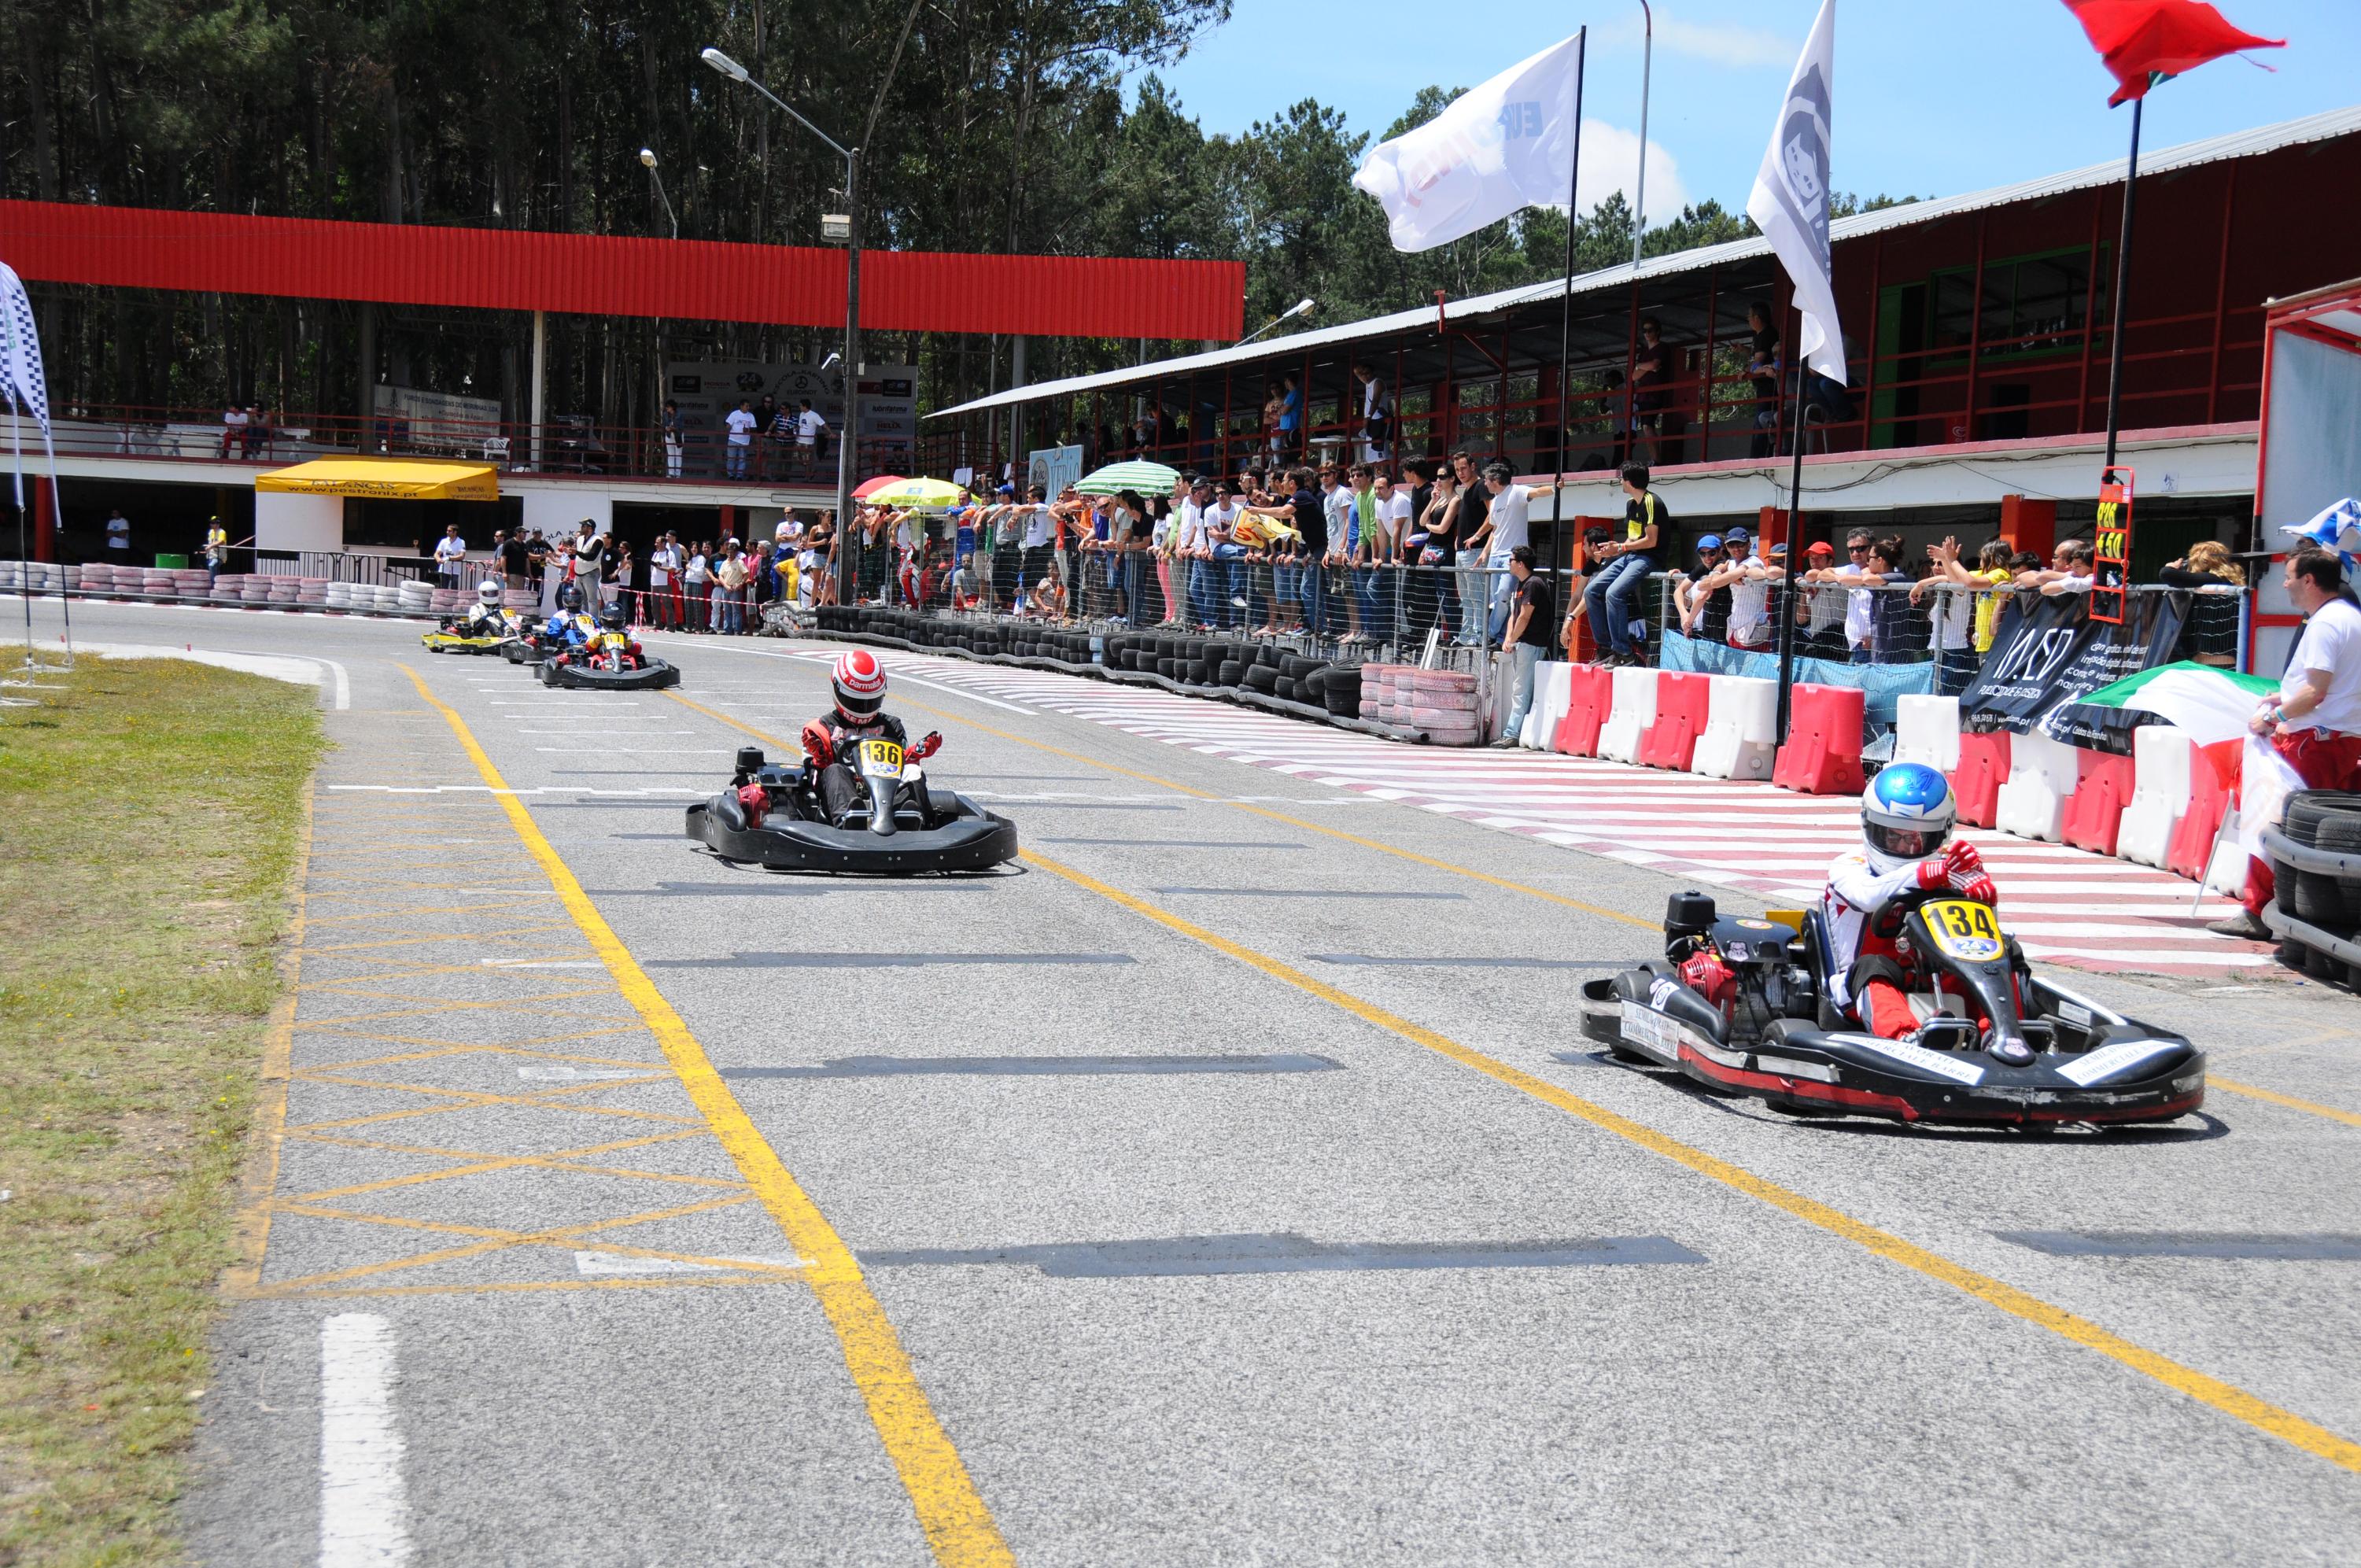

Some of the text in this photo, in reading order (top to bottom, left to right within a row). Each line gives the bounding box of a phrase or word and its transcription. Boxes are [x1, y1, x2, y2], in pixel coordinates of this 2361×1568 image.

[288, 486, 419, 498] www.pestronix.pt
[849, 678, 882, 690] parmalat
[862, 743, 899, 765] 136
[1927, 905, 1995, 939] 134
